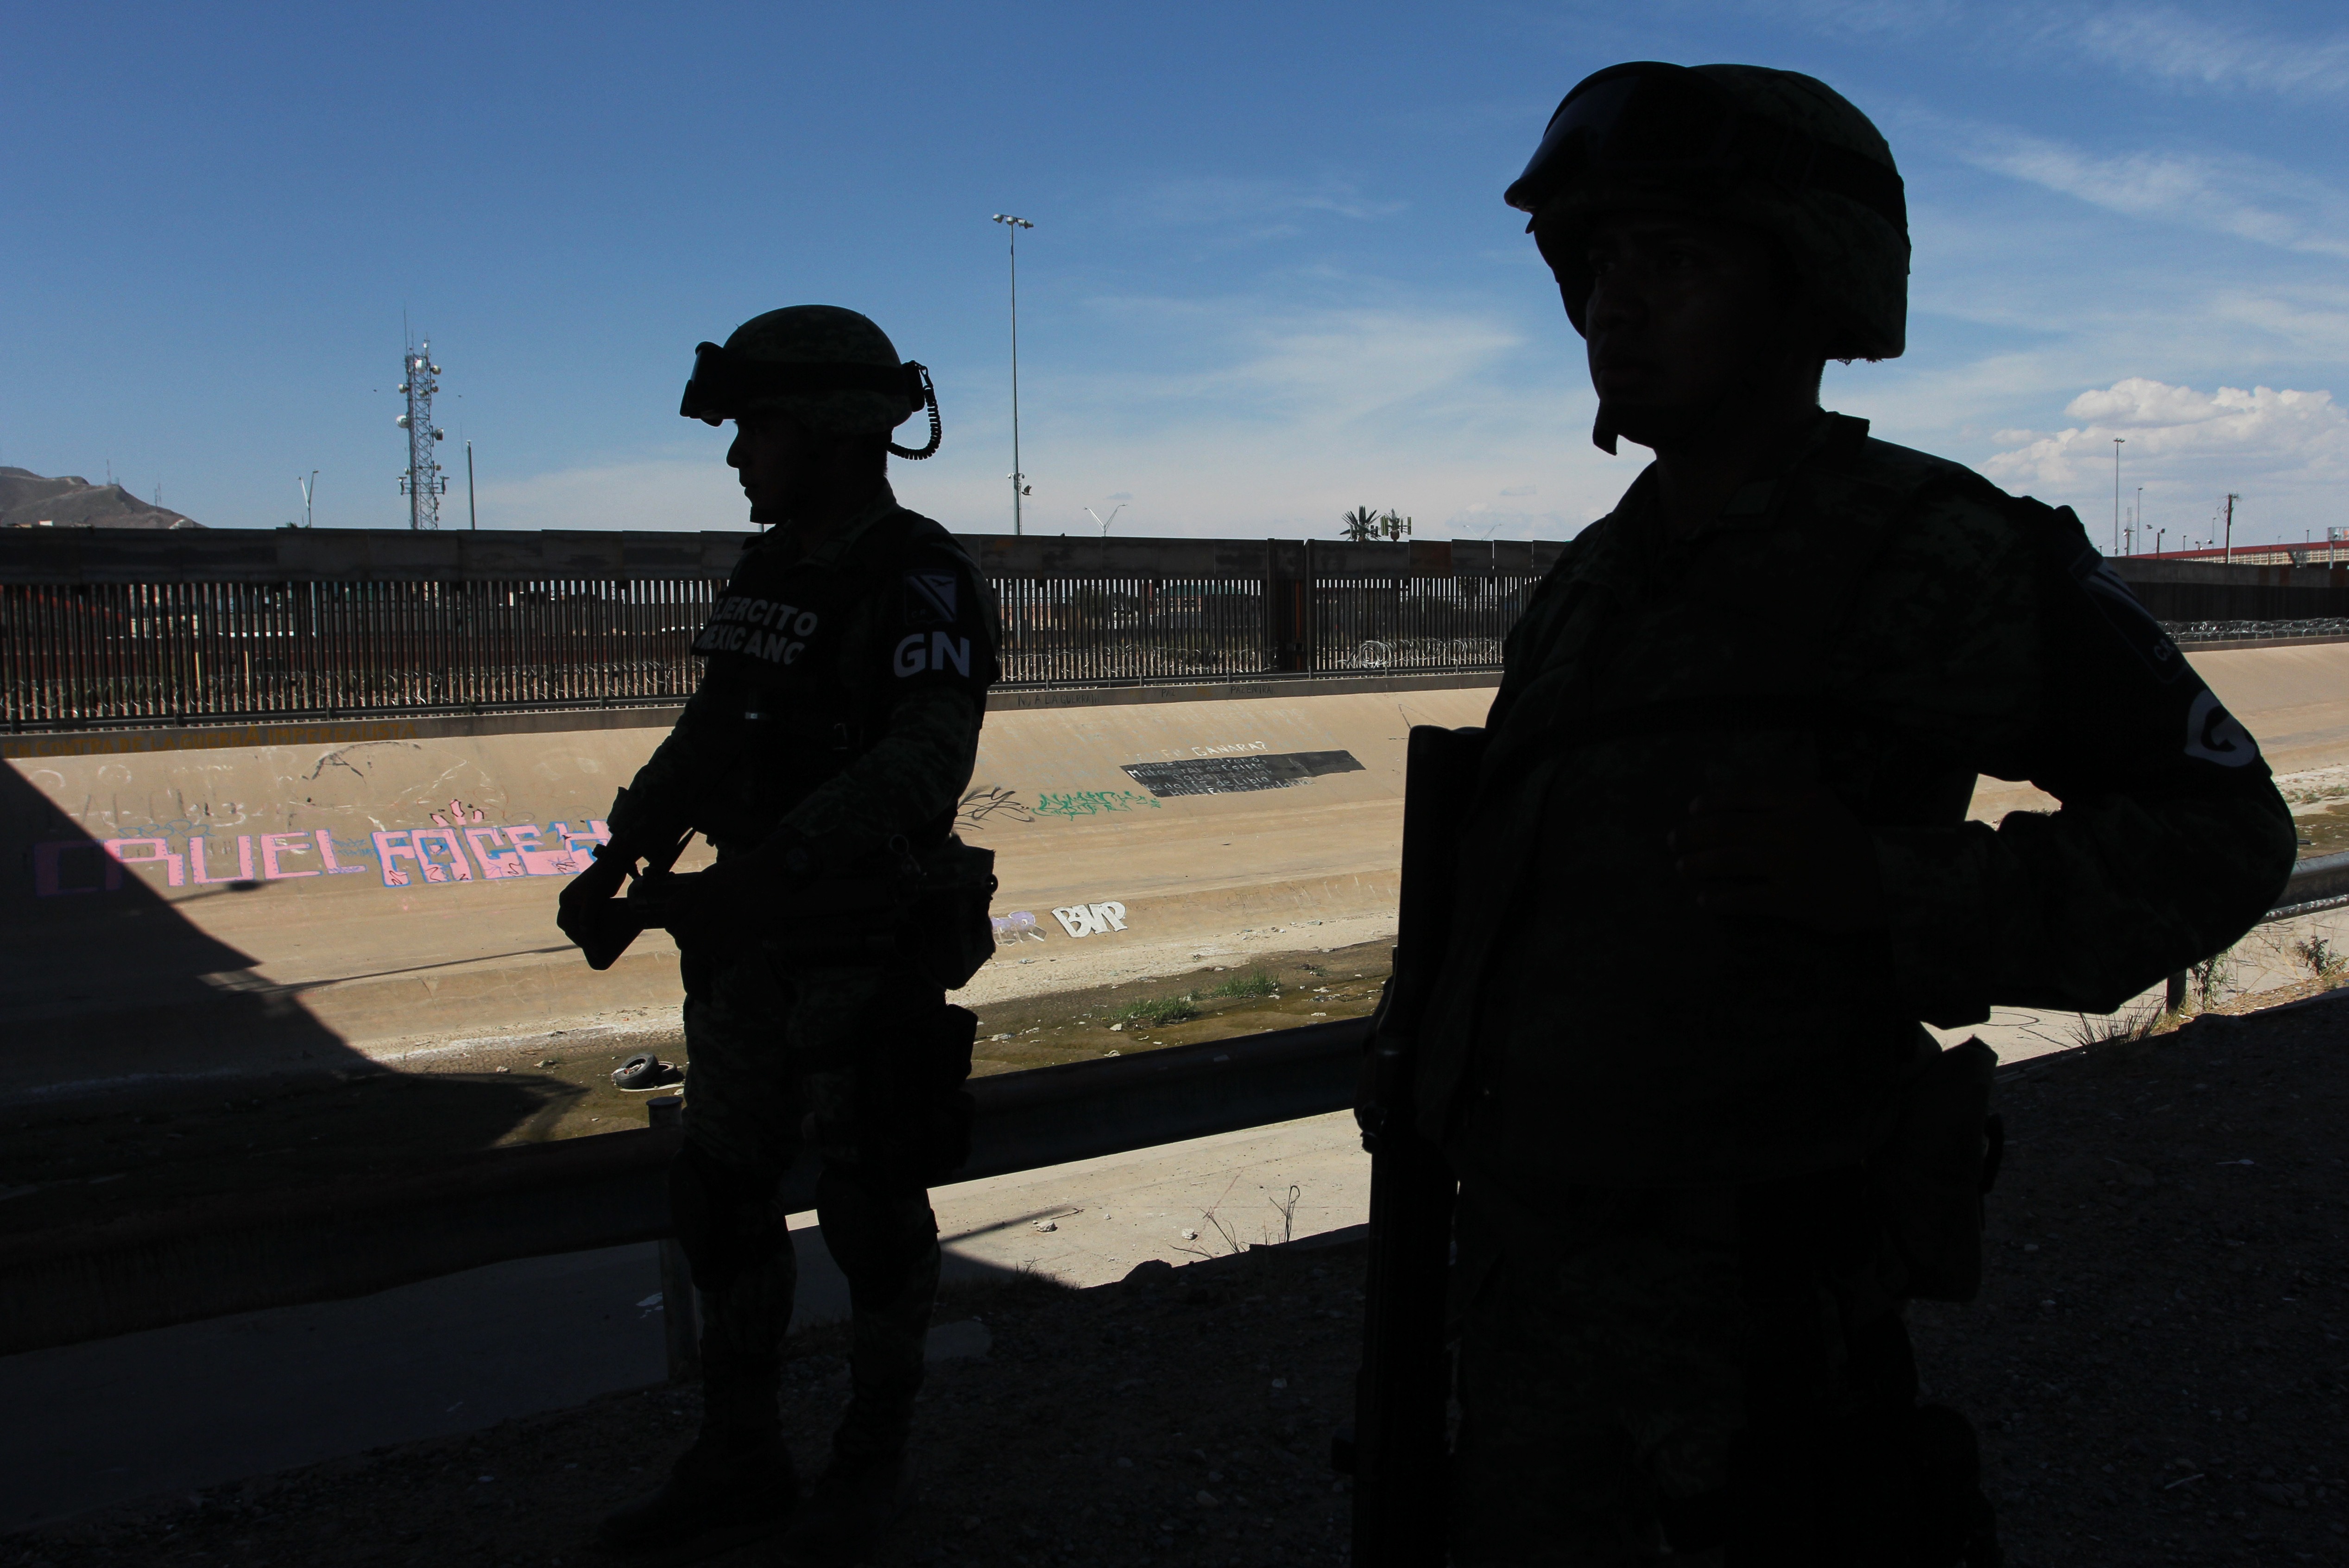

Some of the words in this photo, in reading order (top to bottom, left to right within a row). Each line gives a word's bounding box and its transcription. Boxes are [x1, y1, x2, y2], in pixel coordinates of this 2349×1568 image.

[711, 596, 818, 637] EJERCITO
[892, 631, 970, 679] GN
[1230, 685, 1244, 695] PAZ
[1246, 685, 1257, 694] EN
[1035, 695, 1041, 704] A
[1045, 694, 1058, 704] LA
[1060, 694, 1091, 704] GUERRA
[4, 742, 31, 759] EN
[35, 736, 114, 756] CONTRA
[118, 736, 145, 753] DE
[151, 735, 177, 751] LA
[180, 725, 261, 750] GUERRA
[1191, 740, 1268, 756] GANARA?
[1216, 778, 1233, 787] de
